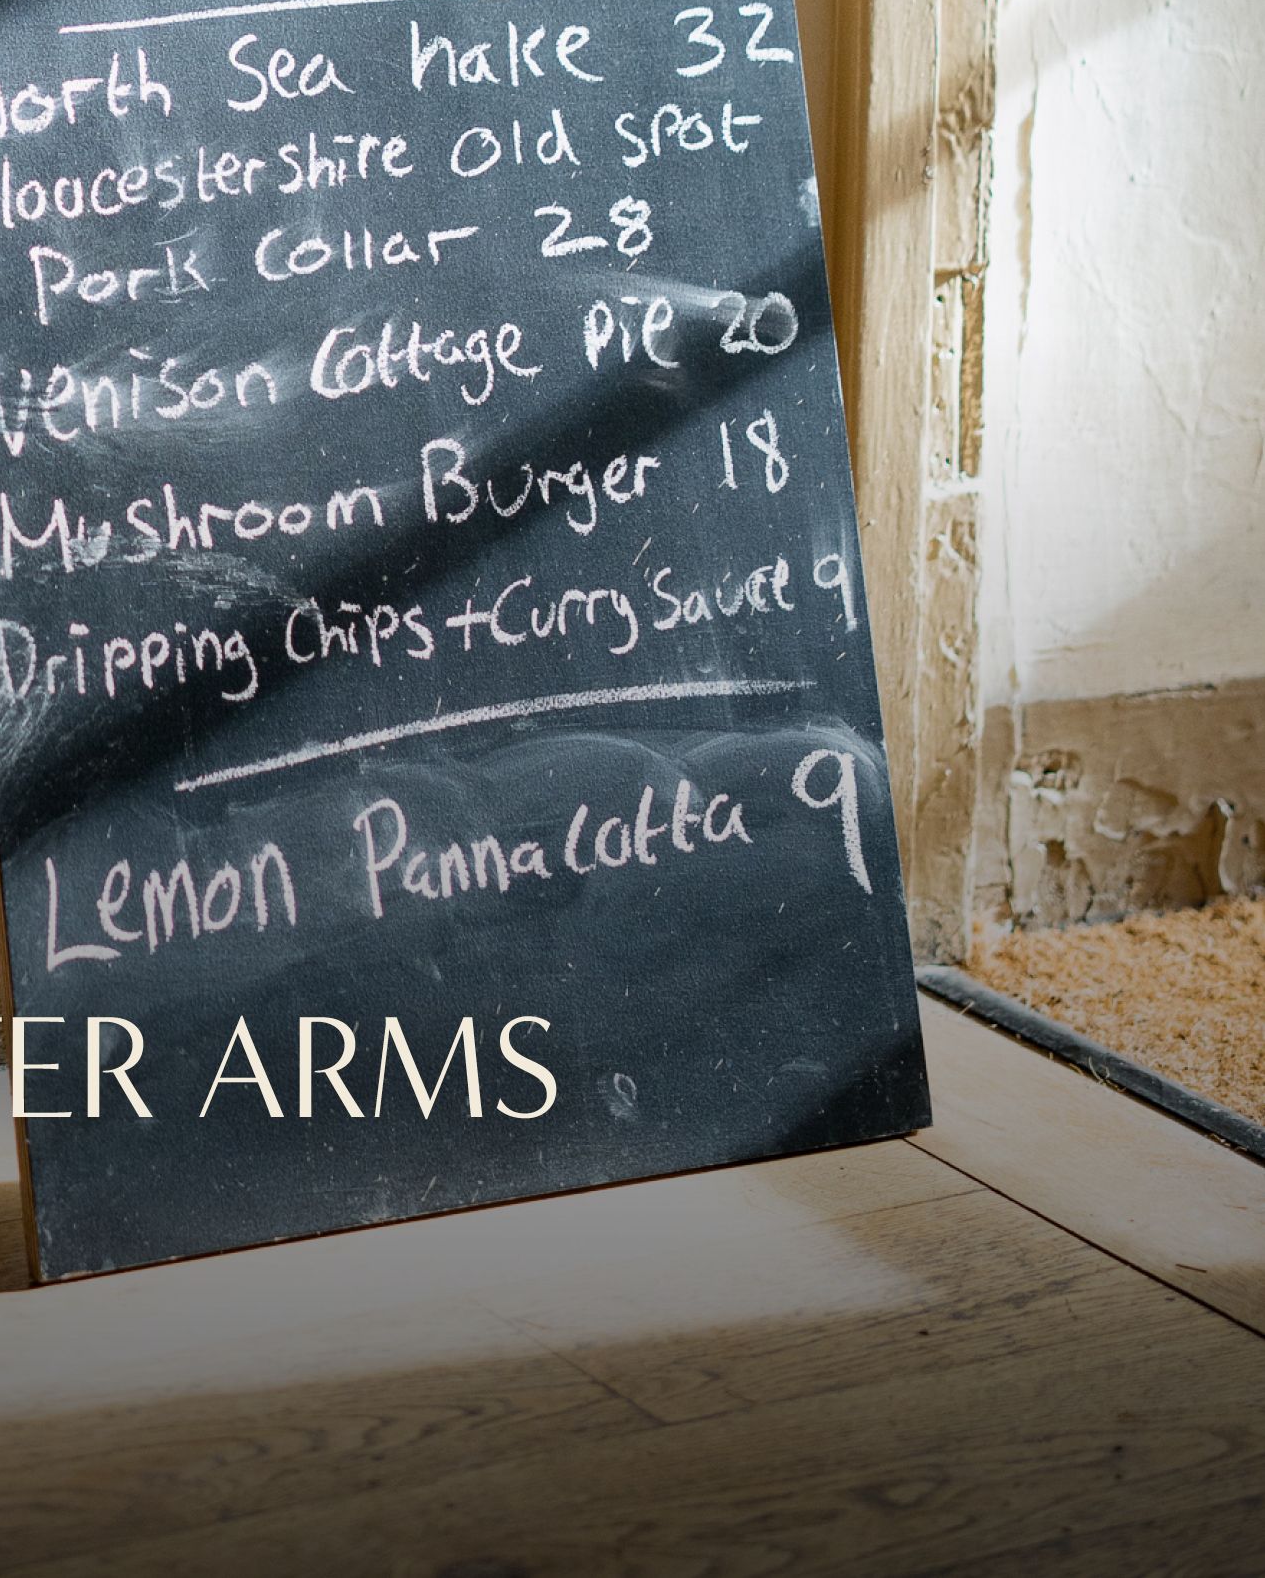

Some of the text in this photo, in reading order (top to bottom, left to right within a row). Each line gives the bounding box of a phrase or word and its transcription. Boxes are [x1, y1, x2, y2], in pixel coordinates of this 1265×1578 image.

[228, 34, 353, 113] Sea
[410, 21, 605, 91] hake
[674, 4, 796, 79] 32
[28, 229, 210, 326] Pork
[541, 197, 654, 260] 28
[717, 290, 799, 355] 20
[0, 413, 792, 578] Mushroom Burger 18
[812, 552, 859, 632] 9
[46, 841, 299, 971] Lemon
[790, 749, 872, 894] 9
